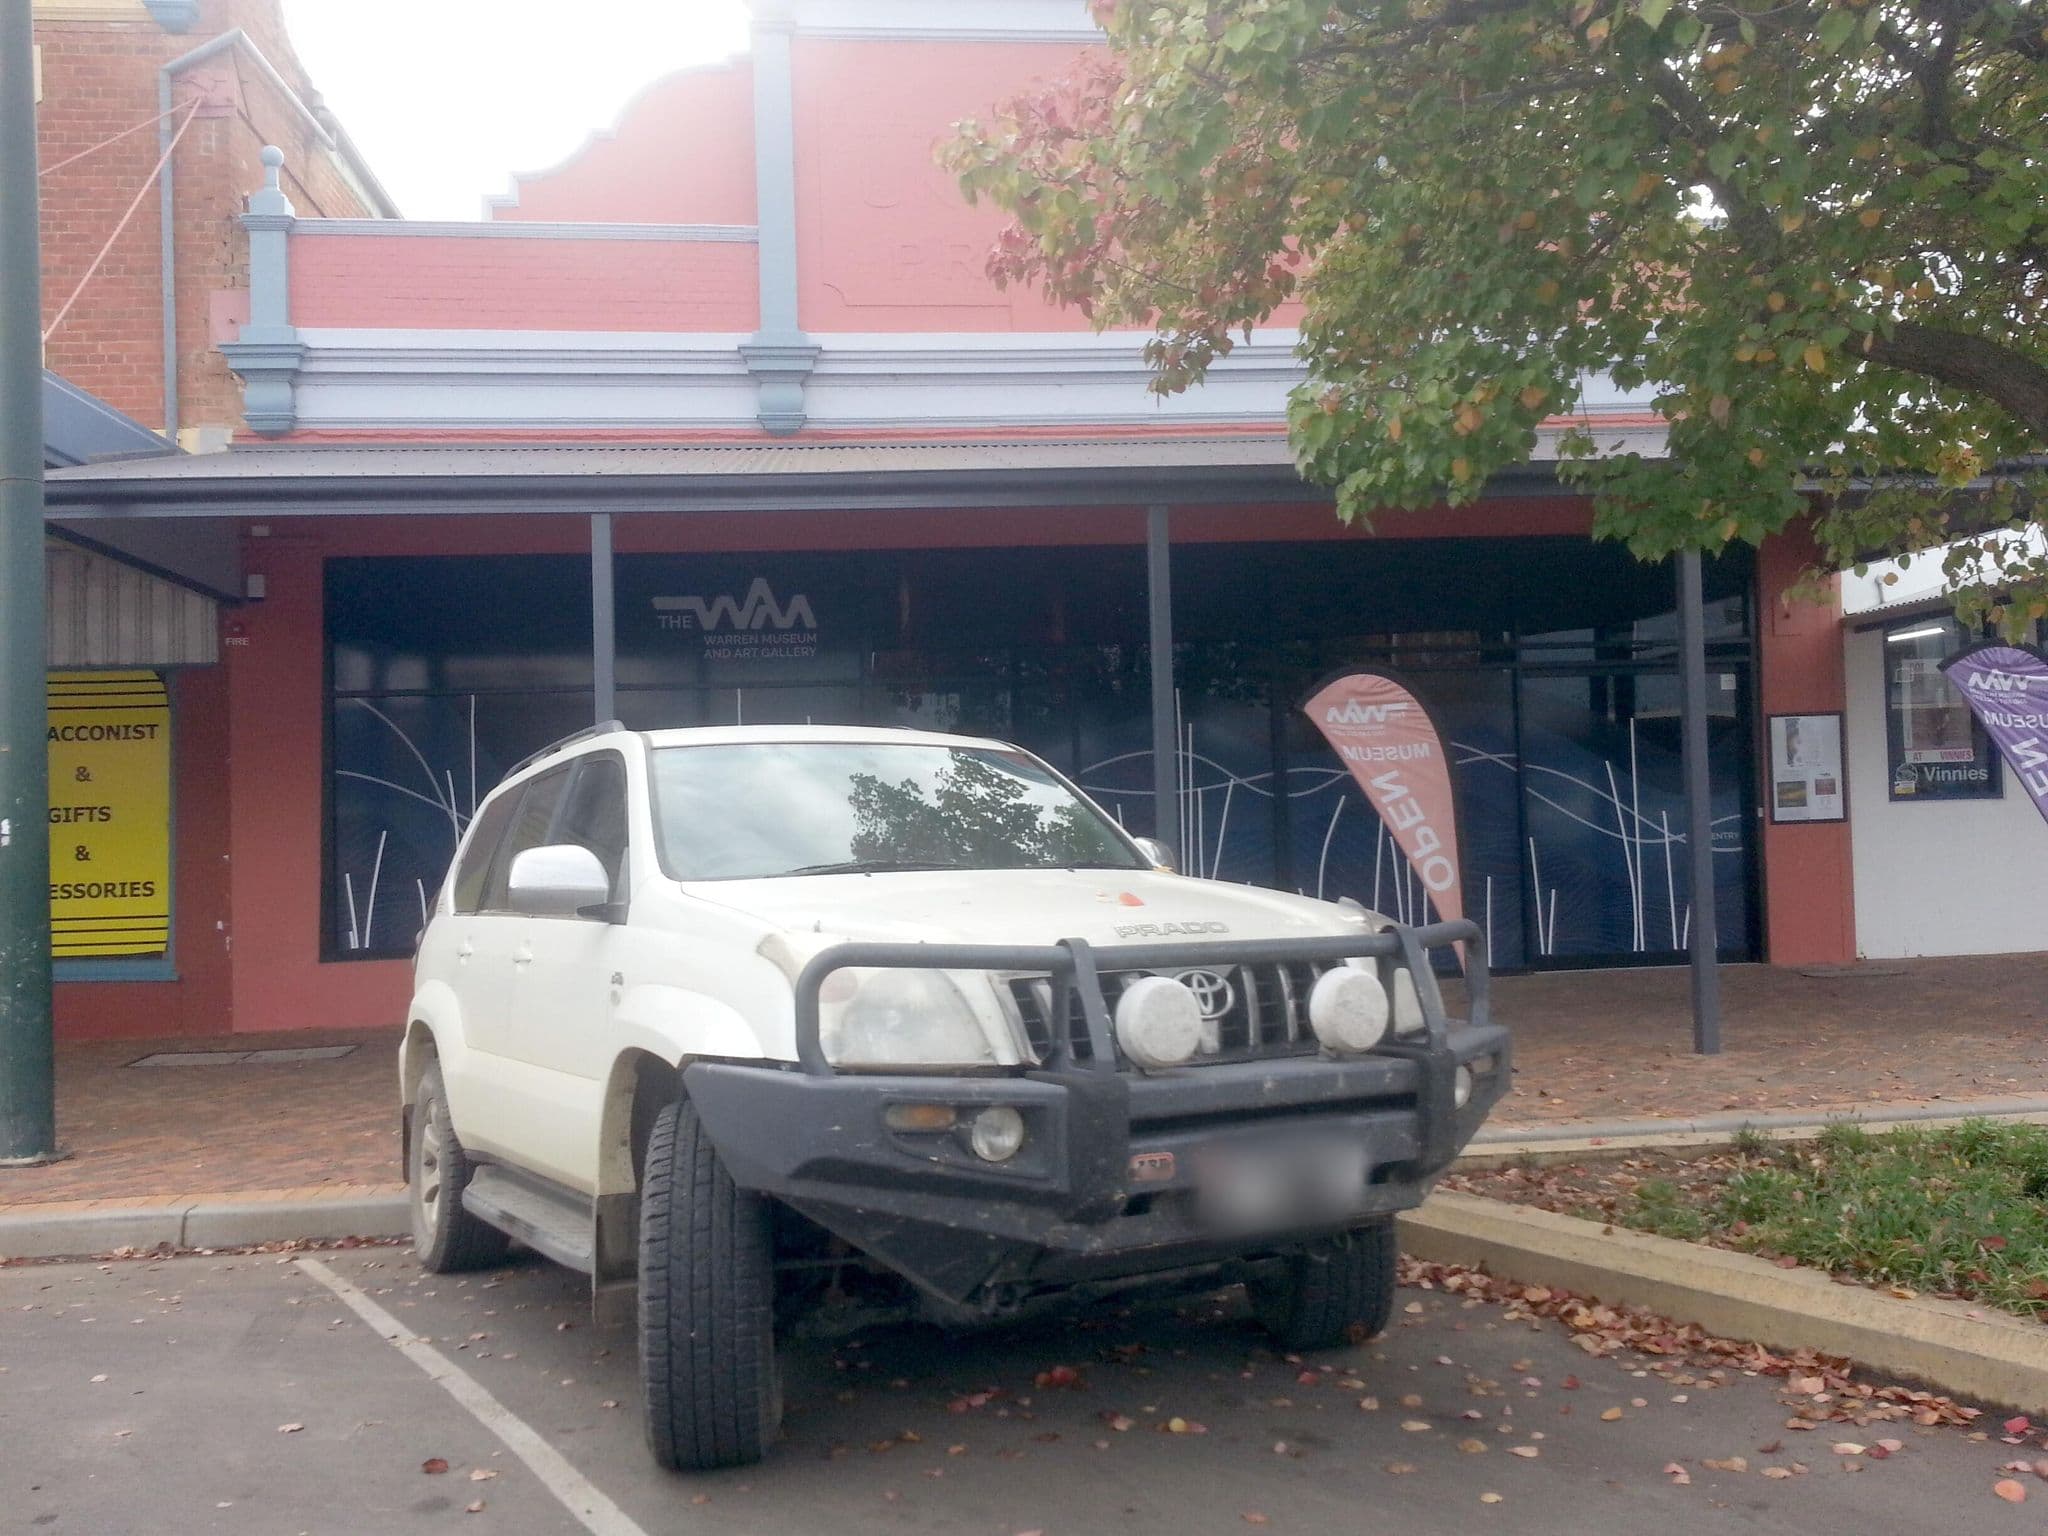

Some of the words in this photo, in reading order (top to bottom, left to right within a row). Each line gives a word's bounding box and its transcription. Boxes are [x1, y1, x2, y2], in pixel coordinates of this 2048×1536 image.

[657, 615, 692, 629] THE
[224, 636, 249, 646] FIRE
[704, 634, 758, 645] WARREN
[762, 633, 817, 644] MUSEUM
[704, 648, 731, 659] AND
[734, 648, 759, 658] ART
[761, 646, 817, 657] GALLERY
[75, 766, 92, 782] &
[1923, 766, 1989, 782] Vinnies
[49, 805, 111, 824] GIFTS
[75, 845, 91, 861] &
[50, 880, 155, 900] ESSORIES
[1113, 921, 1230, 938] PRADO
